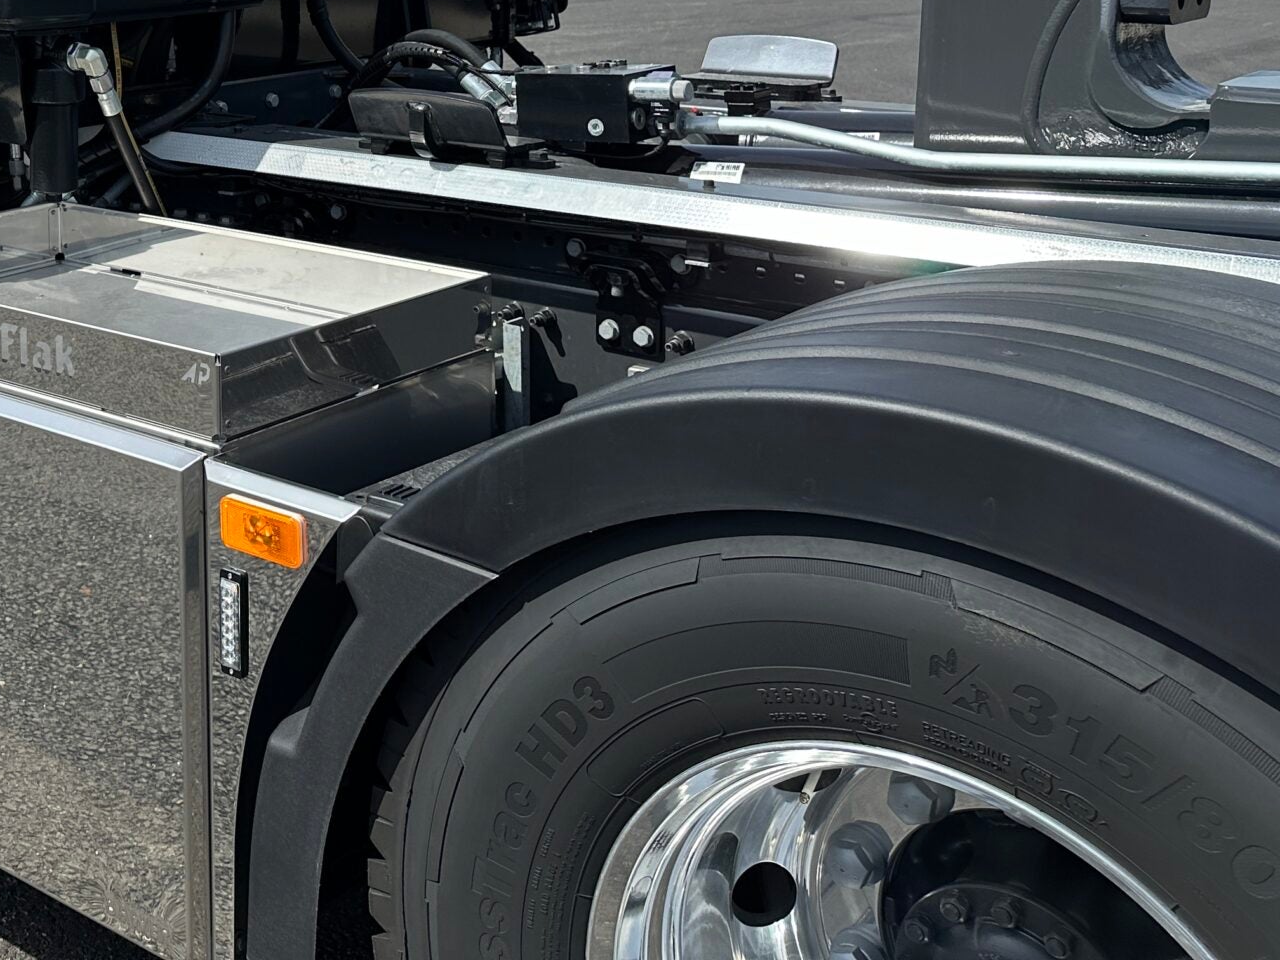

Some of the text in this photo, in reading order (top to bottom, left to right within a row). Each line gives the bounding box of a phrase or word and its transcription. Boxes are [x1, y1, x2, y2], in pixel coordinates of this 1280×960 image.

[515, 676, 615, 781] HD3
[922, 721, 1012, 766] RETREADING
[1008, 684, 1280, 900] 315/80
